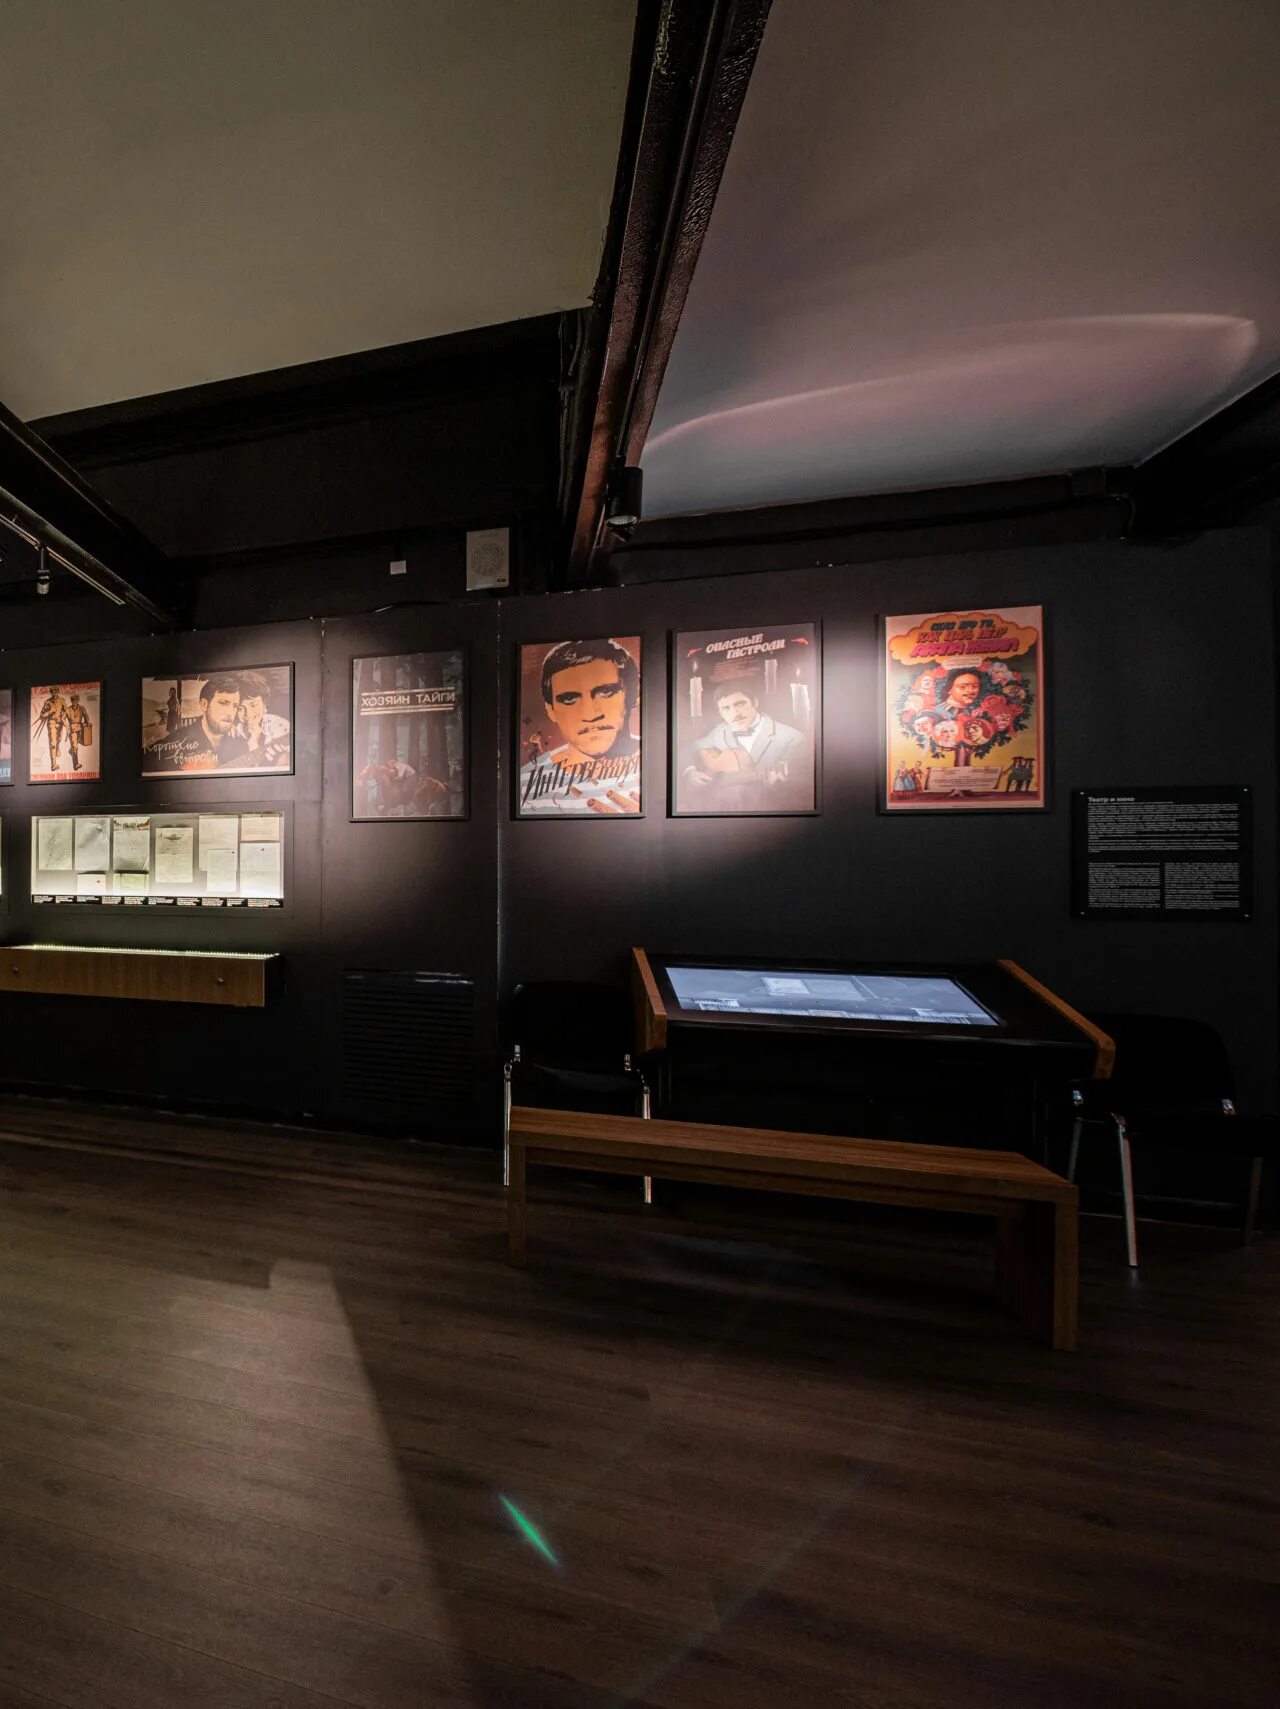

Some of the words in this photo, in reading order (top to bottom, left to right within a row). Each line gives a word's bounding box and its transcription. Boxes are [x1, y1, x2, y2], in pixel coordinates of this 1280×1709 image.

[705, 633, 764, 654] ОПАСНЫЕ
[726, 639, 786, 659] ГАСТРОЛИ
[361, 695, 410, 707] ХОЗЯИН
[416, 692, 455, 703] ТАЙГИ
